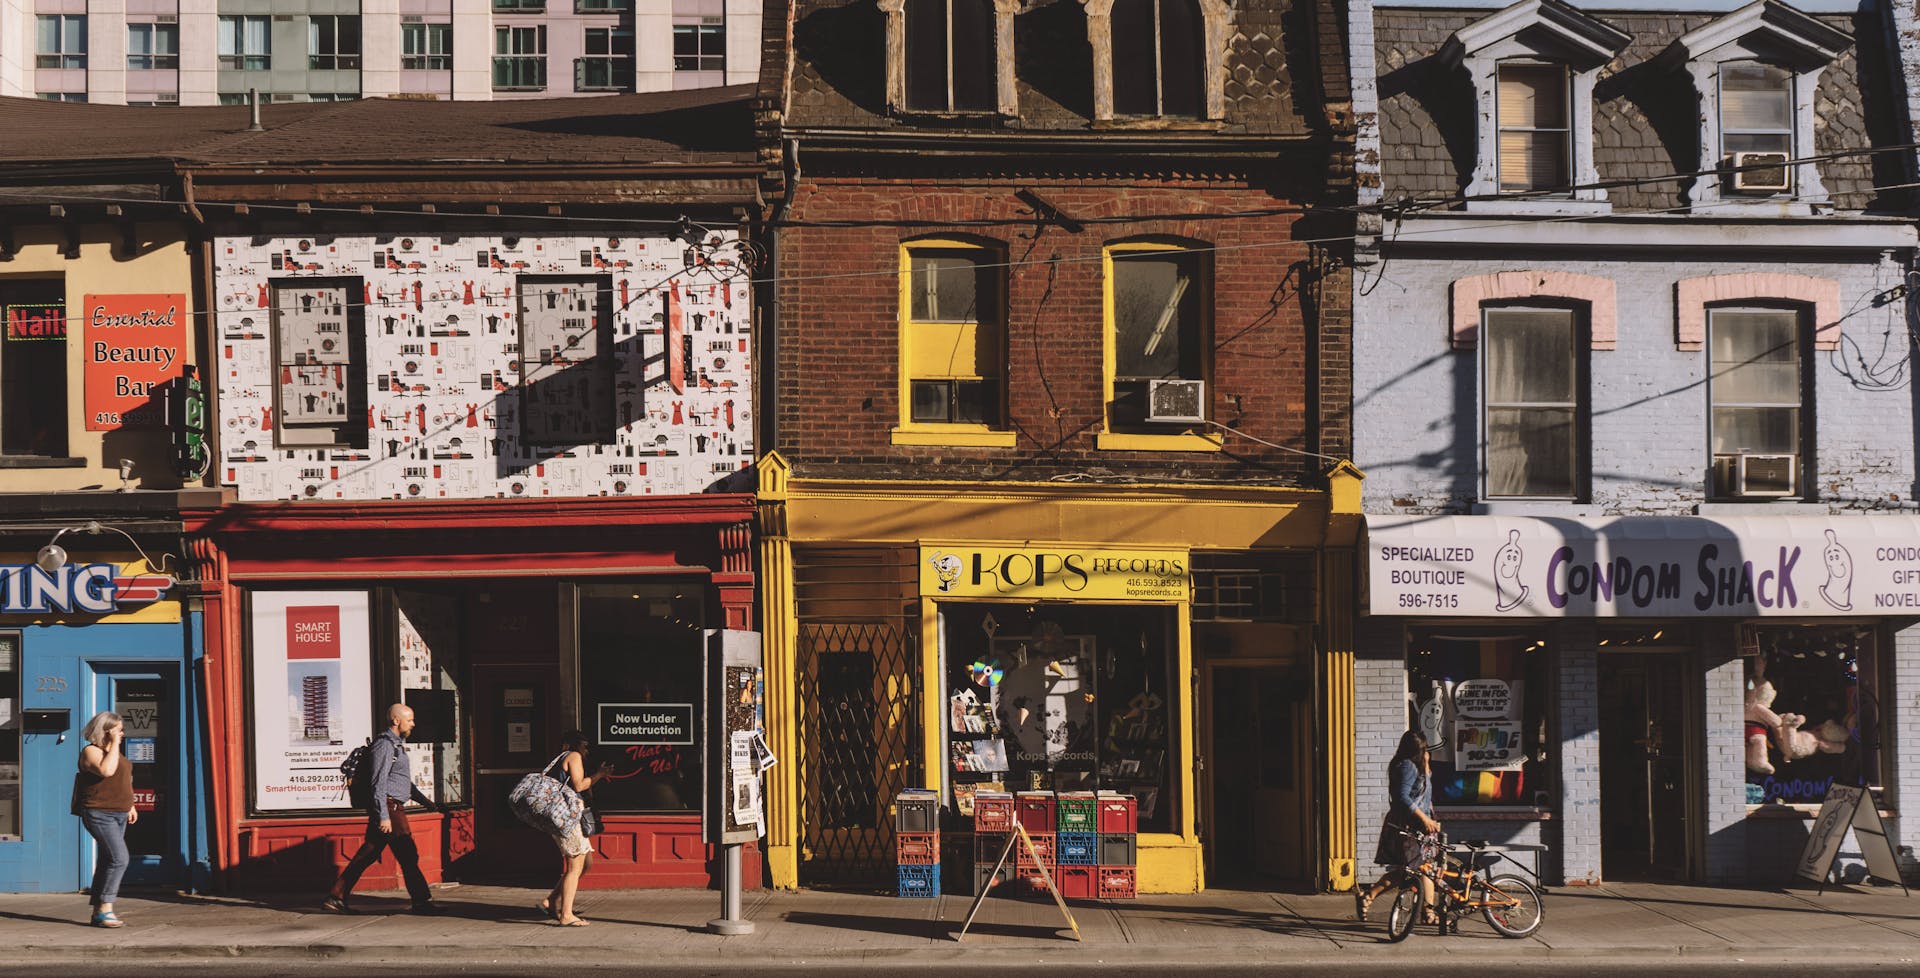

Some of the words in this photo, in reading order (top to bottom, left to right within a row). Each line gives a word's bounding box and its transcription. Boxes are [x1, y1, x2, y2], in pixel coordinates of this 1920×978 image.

[92, 306, 176, 327] Essential
[94, 342, 176, 371] Beauty
[116, 376, 156, 397] Bar
[1381, 547, 1474, 562] SPECIALIZED
[971, 553, 1089, 593] KOPS
[1093, 557, 1184, 577] RECORDS
[1391, 570, 1465, 585] BOUTIQUE
[0, 564, 117, 612] ING
[1126, 579, 1182, 588] 416.593.8523
[1126, 587, 1182, 597] kopsrecords.ca
[1399, 594, 1458, 608] 596-7515
[295, 622, 331, 632] SMART
[295, 633, 333, 642] HOUSE
[35, 676, 67, 692] 225
[1459, 689, 1481, 698] TUNE
[1481, 689, 1491, 698] IN
[1491, 689, 1508, 698] FOR
[616, 713, 640, 723] Now
[642, 713, 677, 723] Under
[610, 725, 682, 735] Construction
[625, 737, 673, 761] That's
[649, 753, 680, 774] Us!
[1016, 751, 1046, 763] Kops
